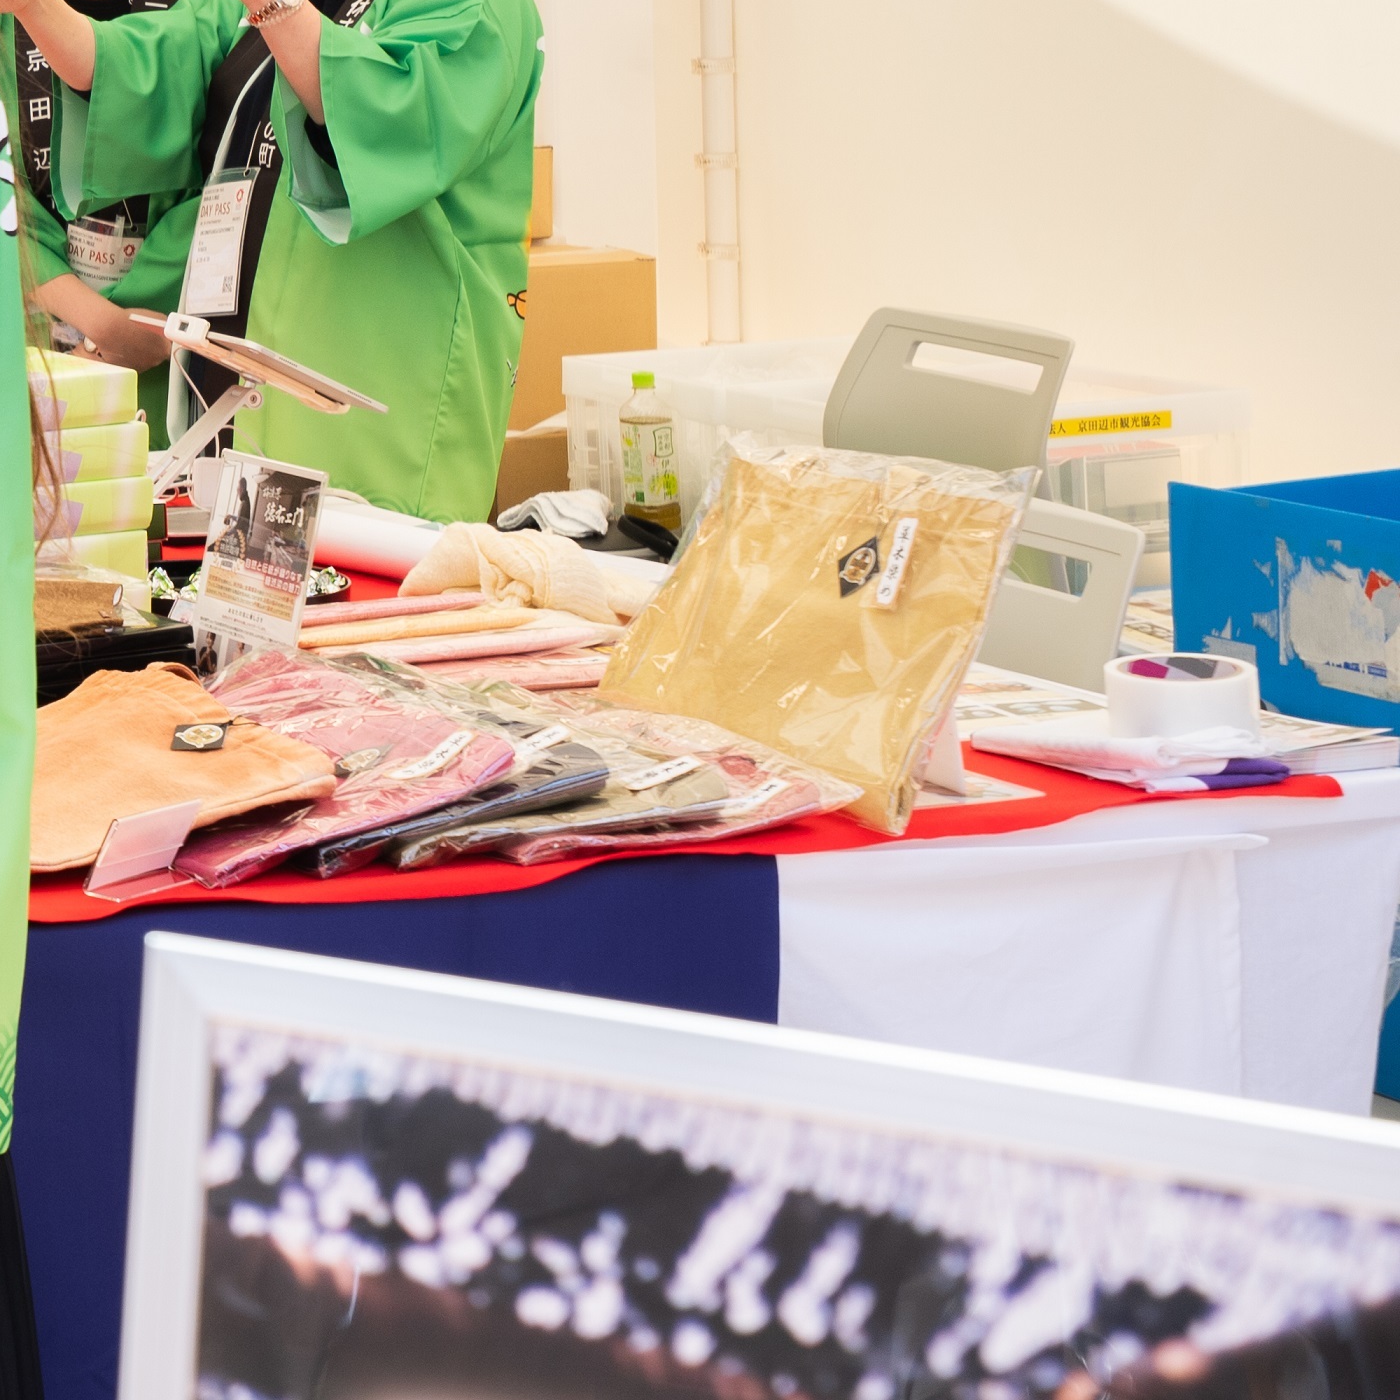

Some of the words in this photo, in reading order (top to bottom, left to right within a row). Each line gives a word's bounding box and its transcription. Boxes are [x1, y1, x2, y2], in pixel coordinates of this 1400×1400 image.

[200, 204, 214, 219] DAY
[214, 201, 232, 216] PASS
[67, 242, 86, 259] DAY
[89, 249, 116, 266] PASS
[1077, 413, 1162, 434] 京田辺市観光協会
